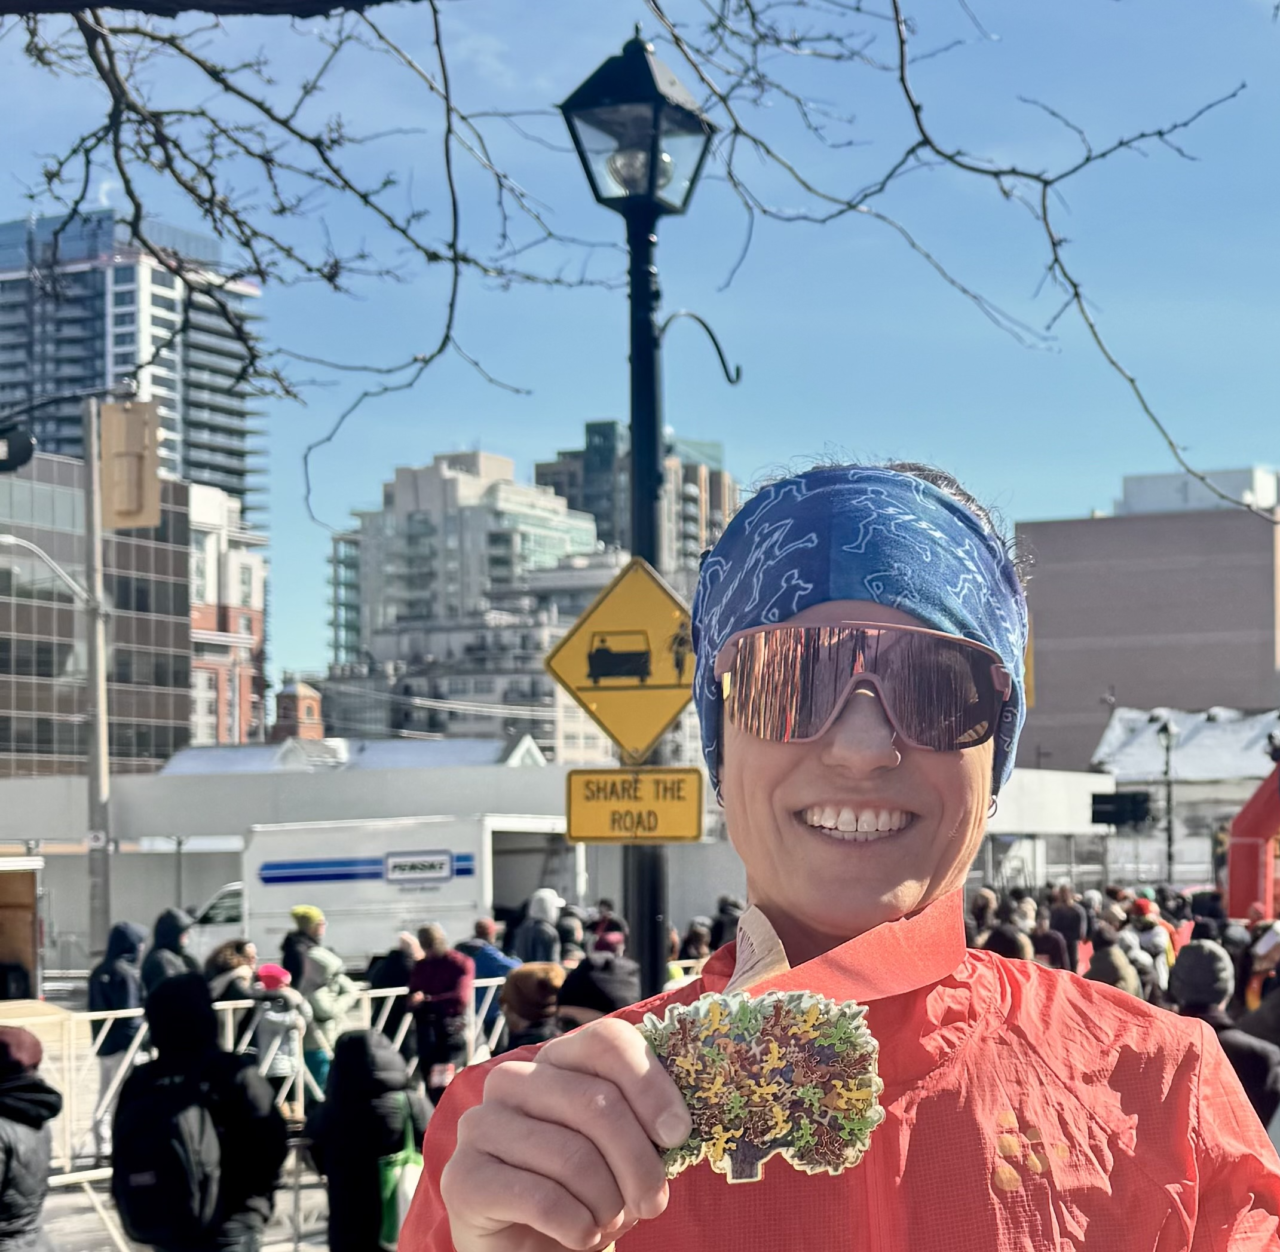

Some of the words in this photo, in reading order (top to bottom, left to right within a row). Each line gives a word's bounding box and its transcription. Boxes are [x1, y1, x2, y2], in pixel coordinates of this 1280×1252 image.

[584, 777, 643, 801] SHARE
[654, 777, 687, 801] THE
[610, 809, 658, 832] ROAD
